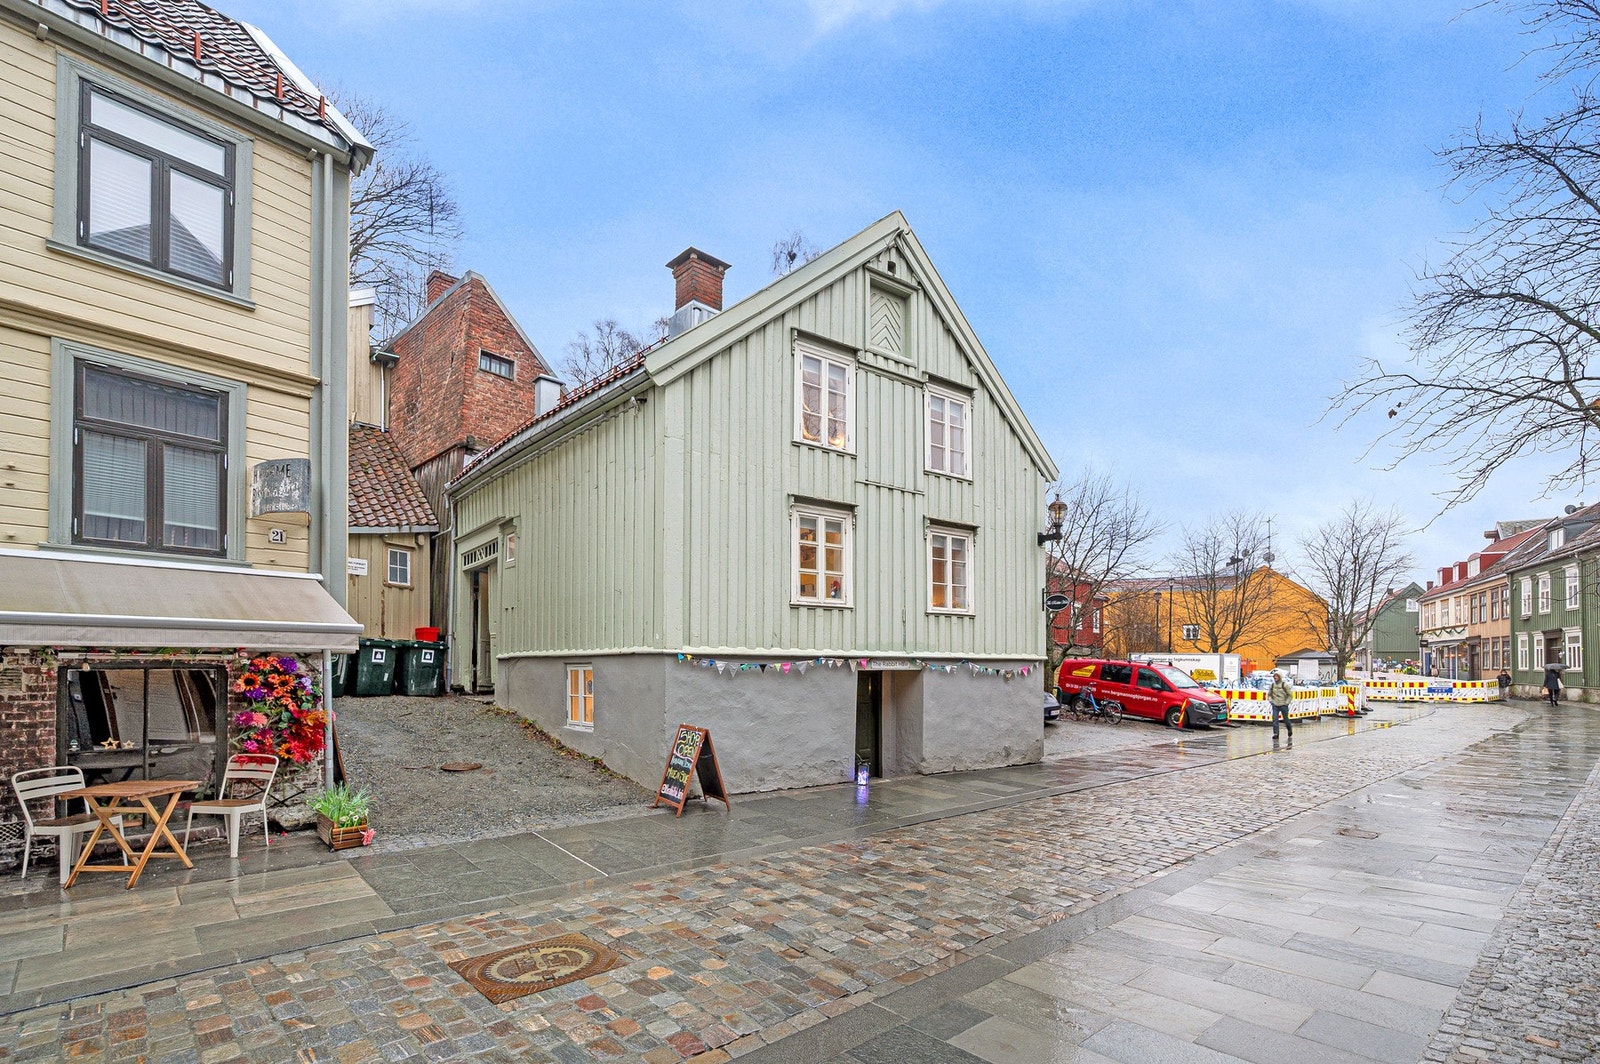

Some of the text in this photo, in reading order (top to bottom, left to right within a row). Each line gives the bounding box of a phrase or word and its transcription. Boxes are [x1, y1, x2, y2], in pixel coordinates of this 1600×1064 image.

[271, 530, 283, 542] 21
[678, 731, 702, 746] SHOP
[678, 744, 697, 758] OPEN
